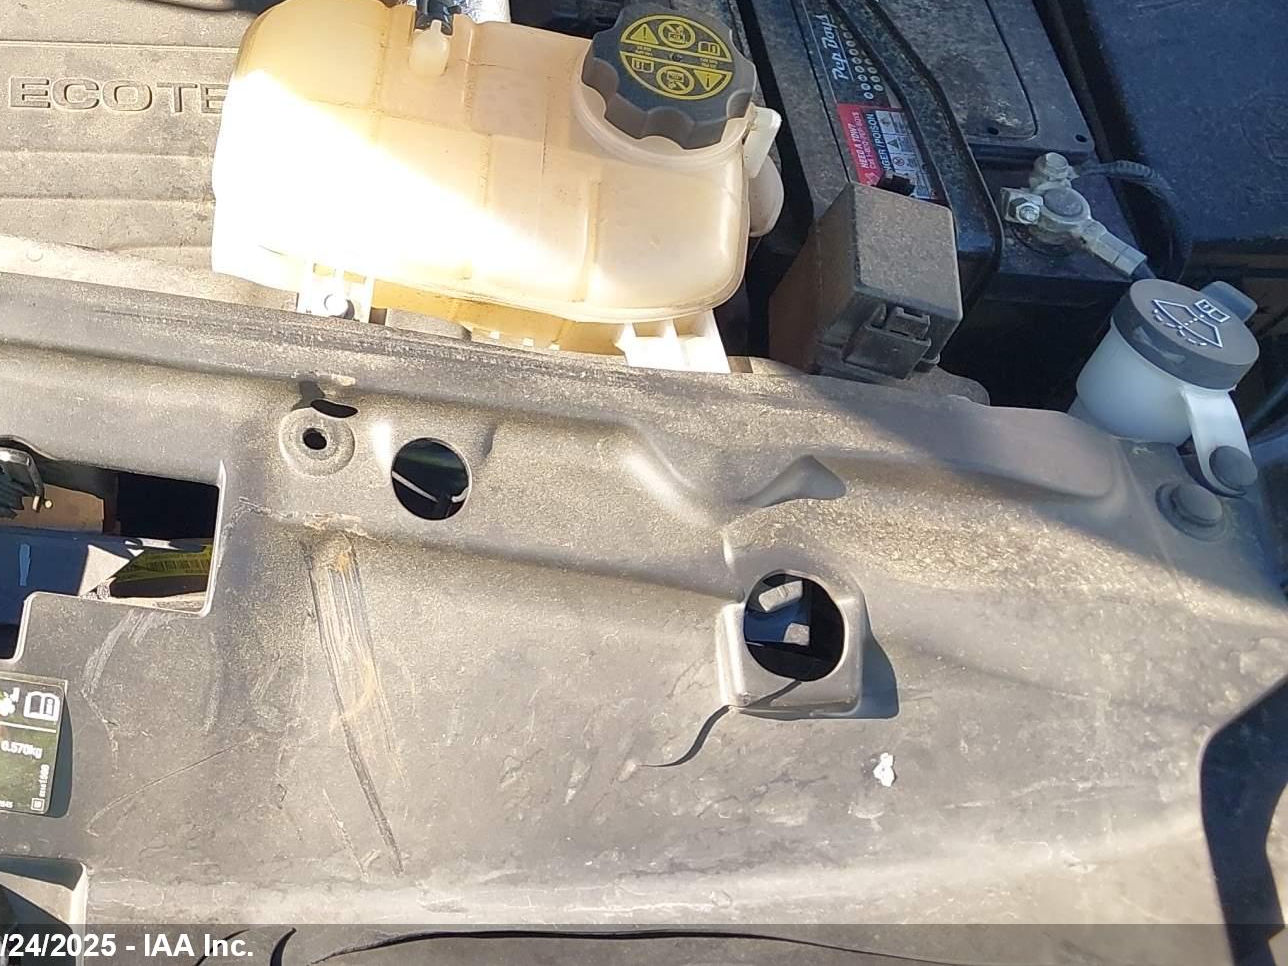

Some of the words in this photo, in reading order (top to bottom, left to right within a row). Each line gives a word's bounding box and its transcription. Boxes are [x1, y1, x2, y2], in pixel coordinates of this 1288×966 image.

[815, 14, 838, 49] Boys
[832, 53, 849, 80] Pep
[8, 76, 229, 114] ECOTE
[856, 149, 869, 169] NEED
[1, 740, 43, 759] 0.570kg
